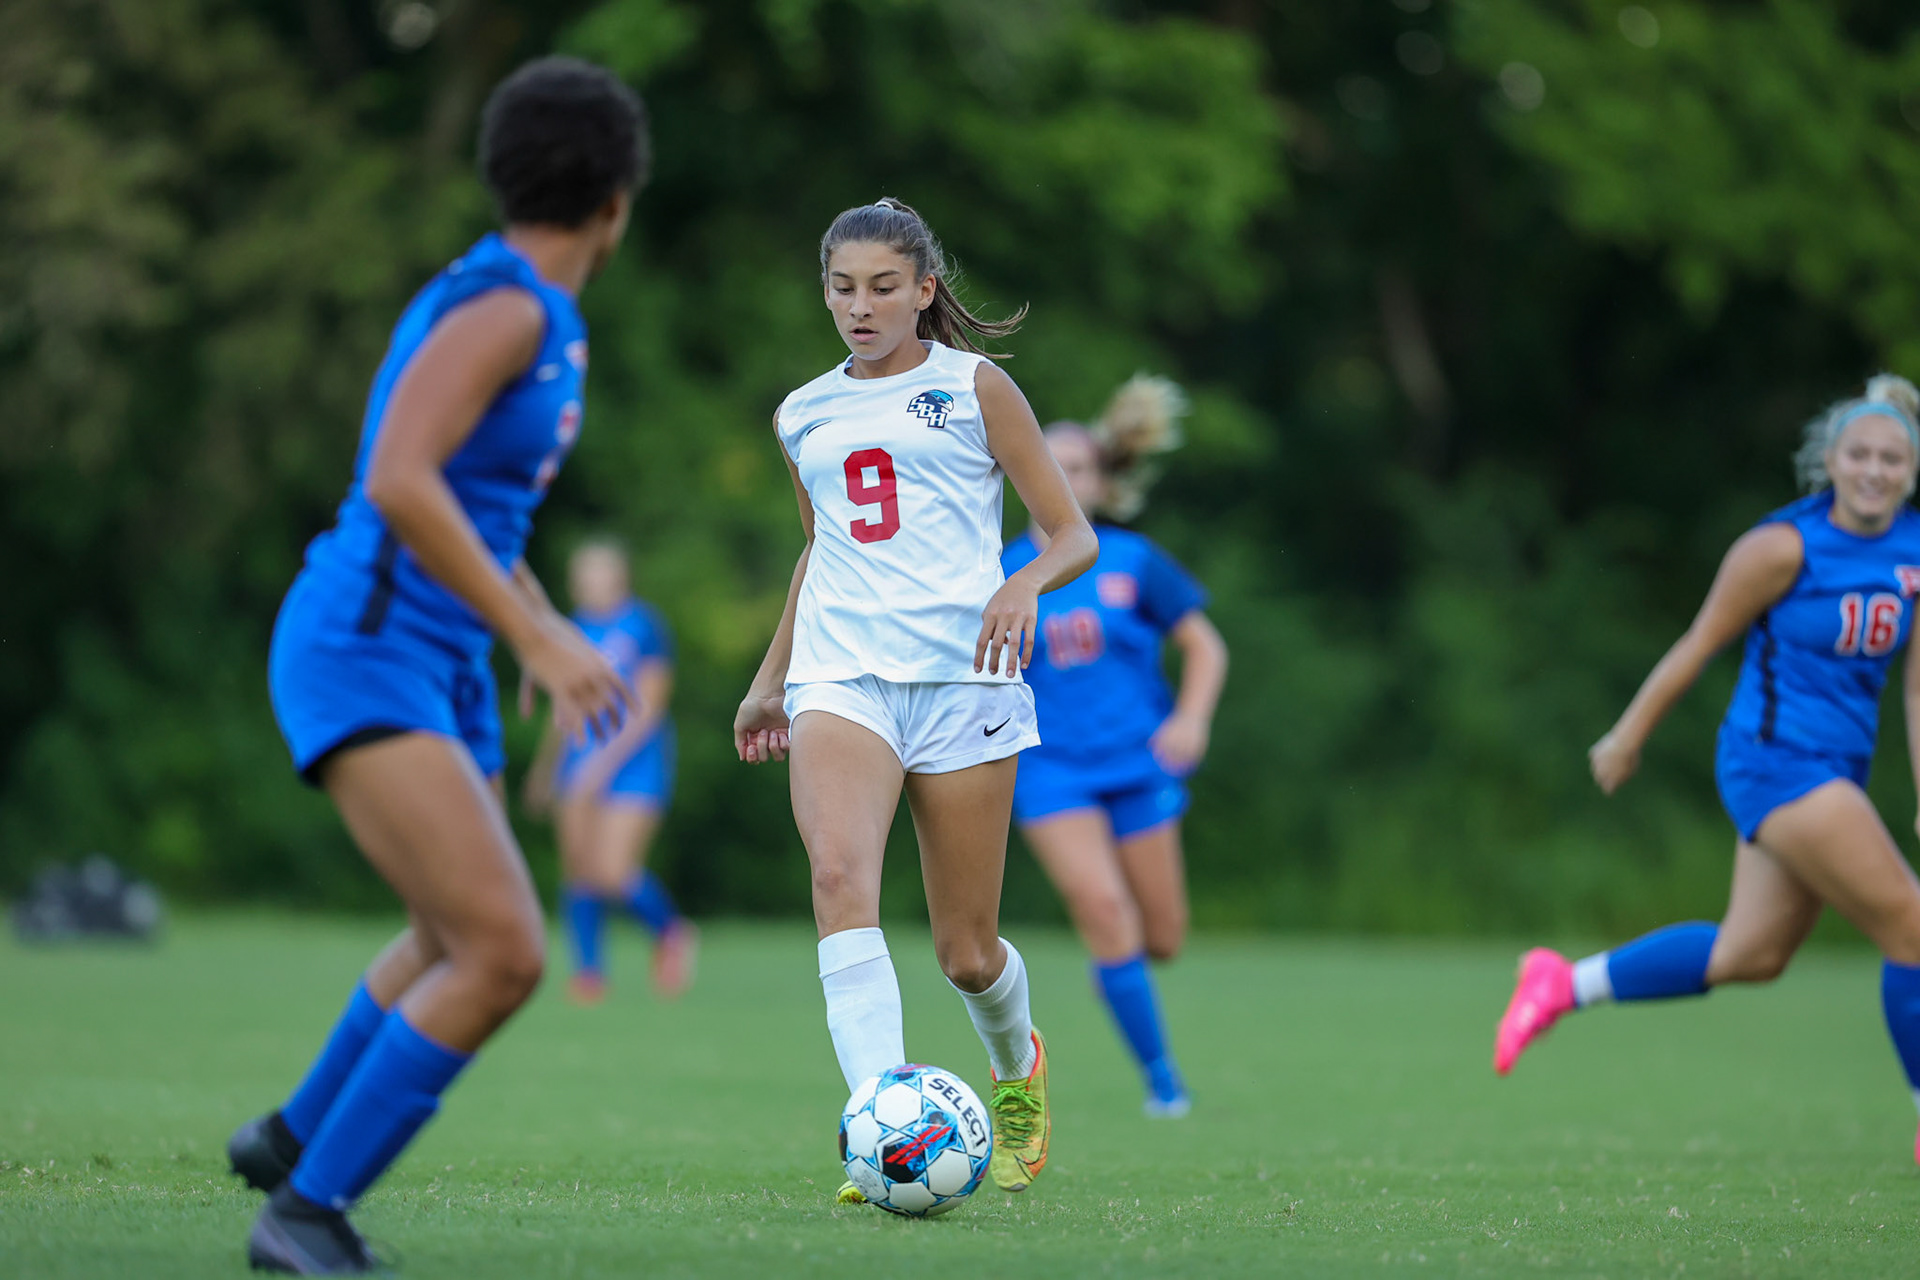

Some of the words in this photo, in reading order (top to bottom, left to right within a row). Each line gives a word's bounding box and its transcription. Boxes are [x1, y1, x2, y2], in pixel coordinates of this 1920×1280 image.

[907, 396, 947, 428] SBA
[844, 448, 900, 544] 9
[1835, 591, 1903, 657] 16
[928, 1078, 987, 1147] SELECT
